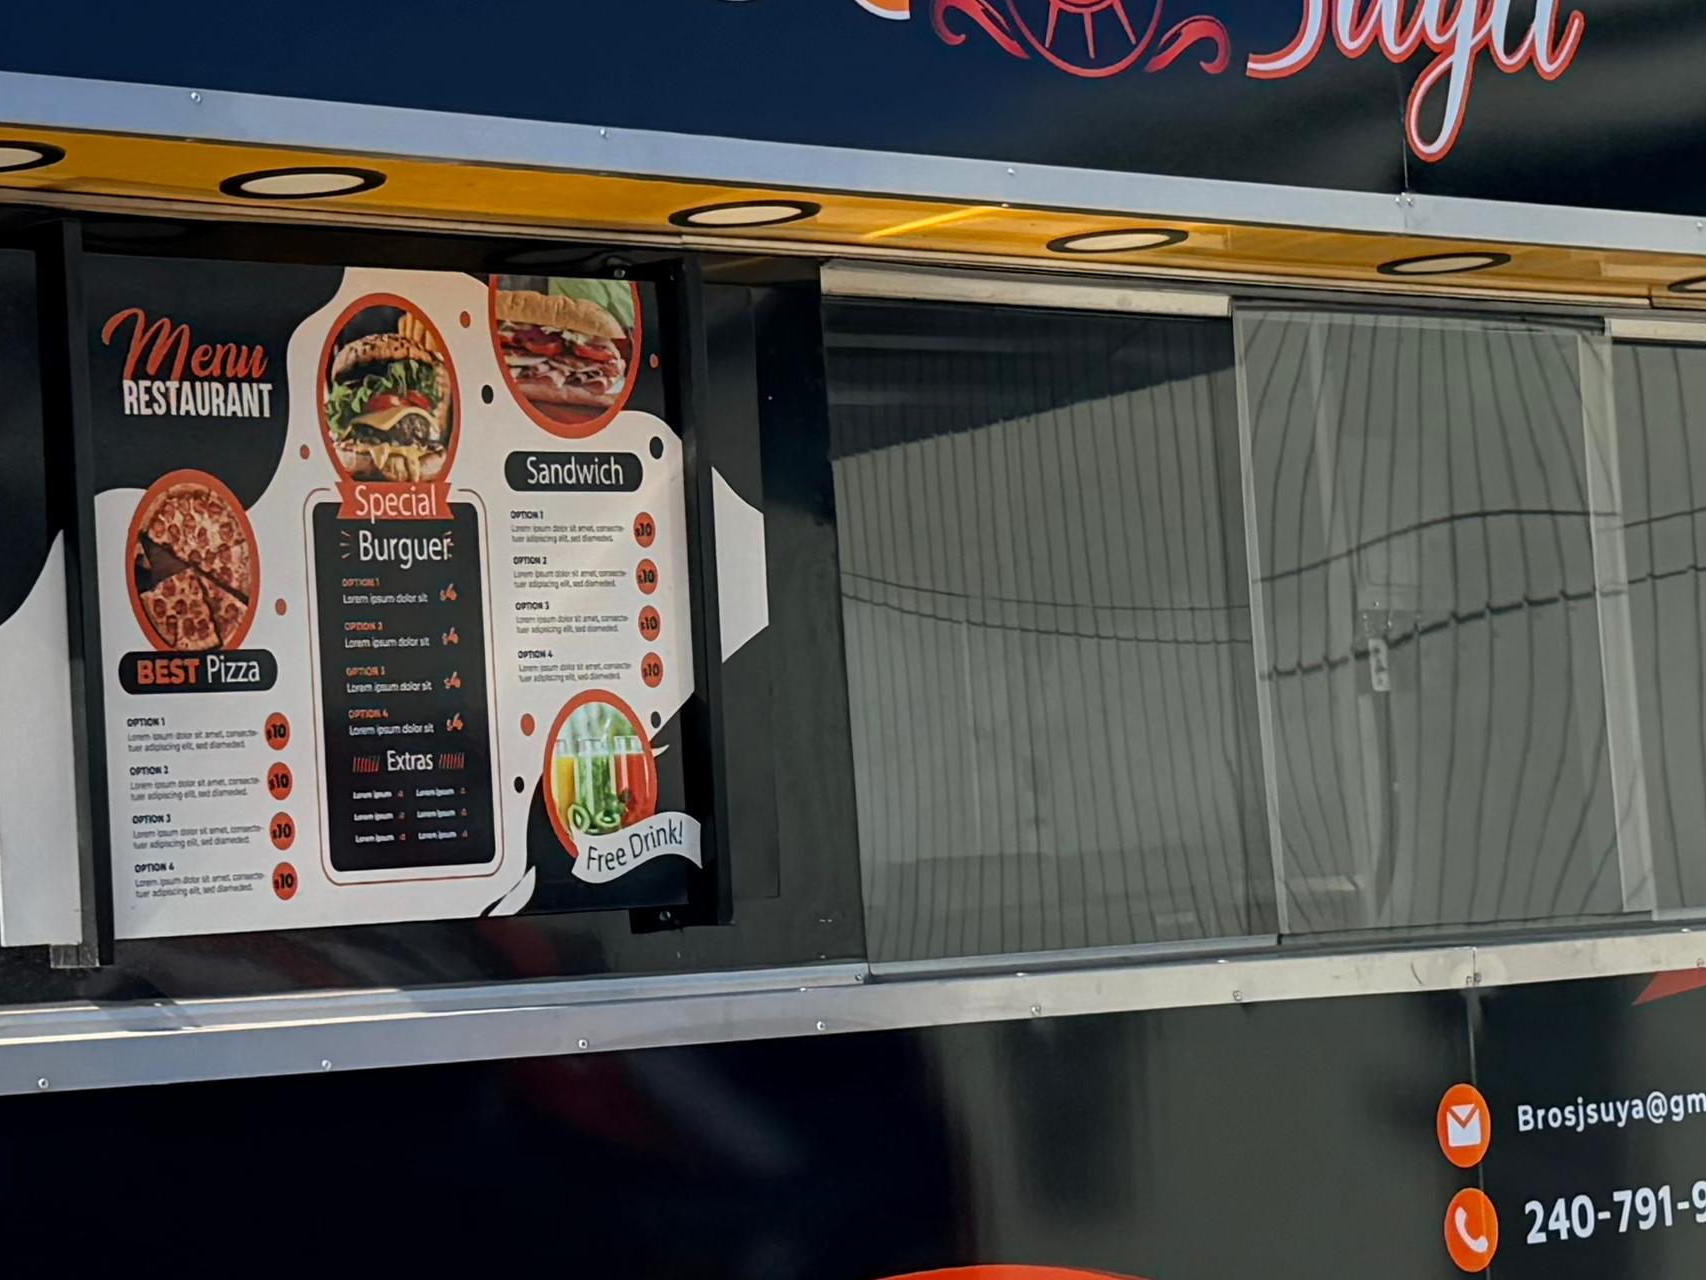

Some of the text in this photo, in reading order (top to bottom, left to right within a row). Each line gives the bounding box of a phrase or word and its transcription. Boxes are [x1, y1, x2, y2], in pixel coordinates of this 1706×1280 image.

[101, 307, 268, 382] Menu
[122, 379, 273, 418] RESTAURANT
[526, 456, 624, 485] Sandwich
[354, 484, 437, 524] Special
[511, 511, 538, 519] OPTION
[359, 530, 451, 569] Burguer
[513, 557, 541, 565] OPTION
[515, 602, 543, 610] OPTION
[136, 654, 261, 685] BEST Pizza
[127, 718, 159, 727] OPTION
[130, 767, 162, 775] OPTION
[386, 750, 434, 771] Extras
[132, 816, 164, 824] OPTION
[586, 818, 683, 872] Free Drink!
[135, 865, 166, 873] OPTION
